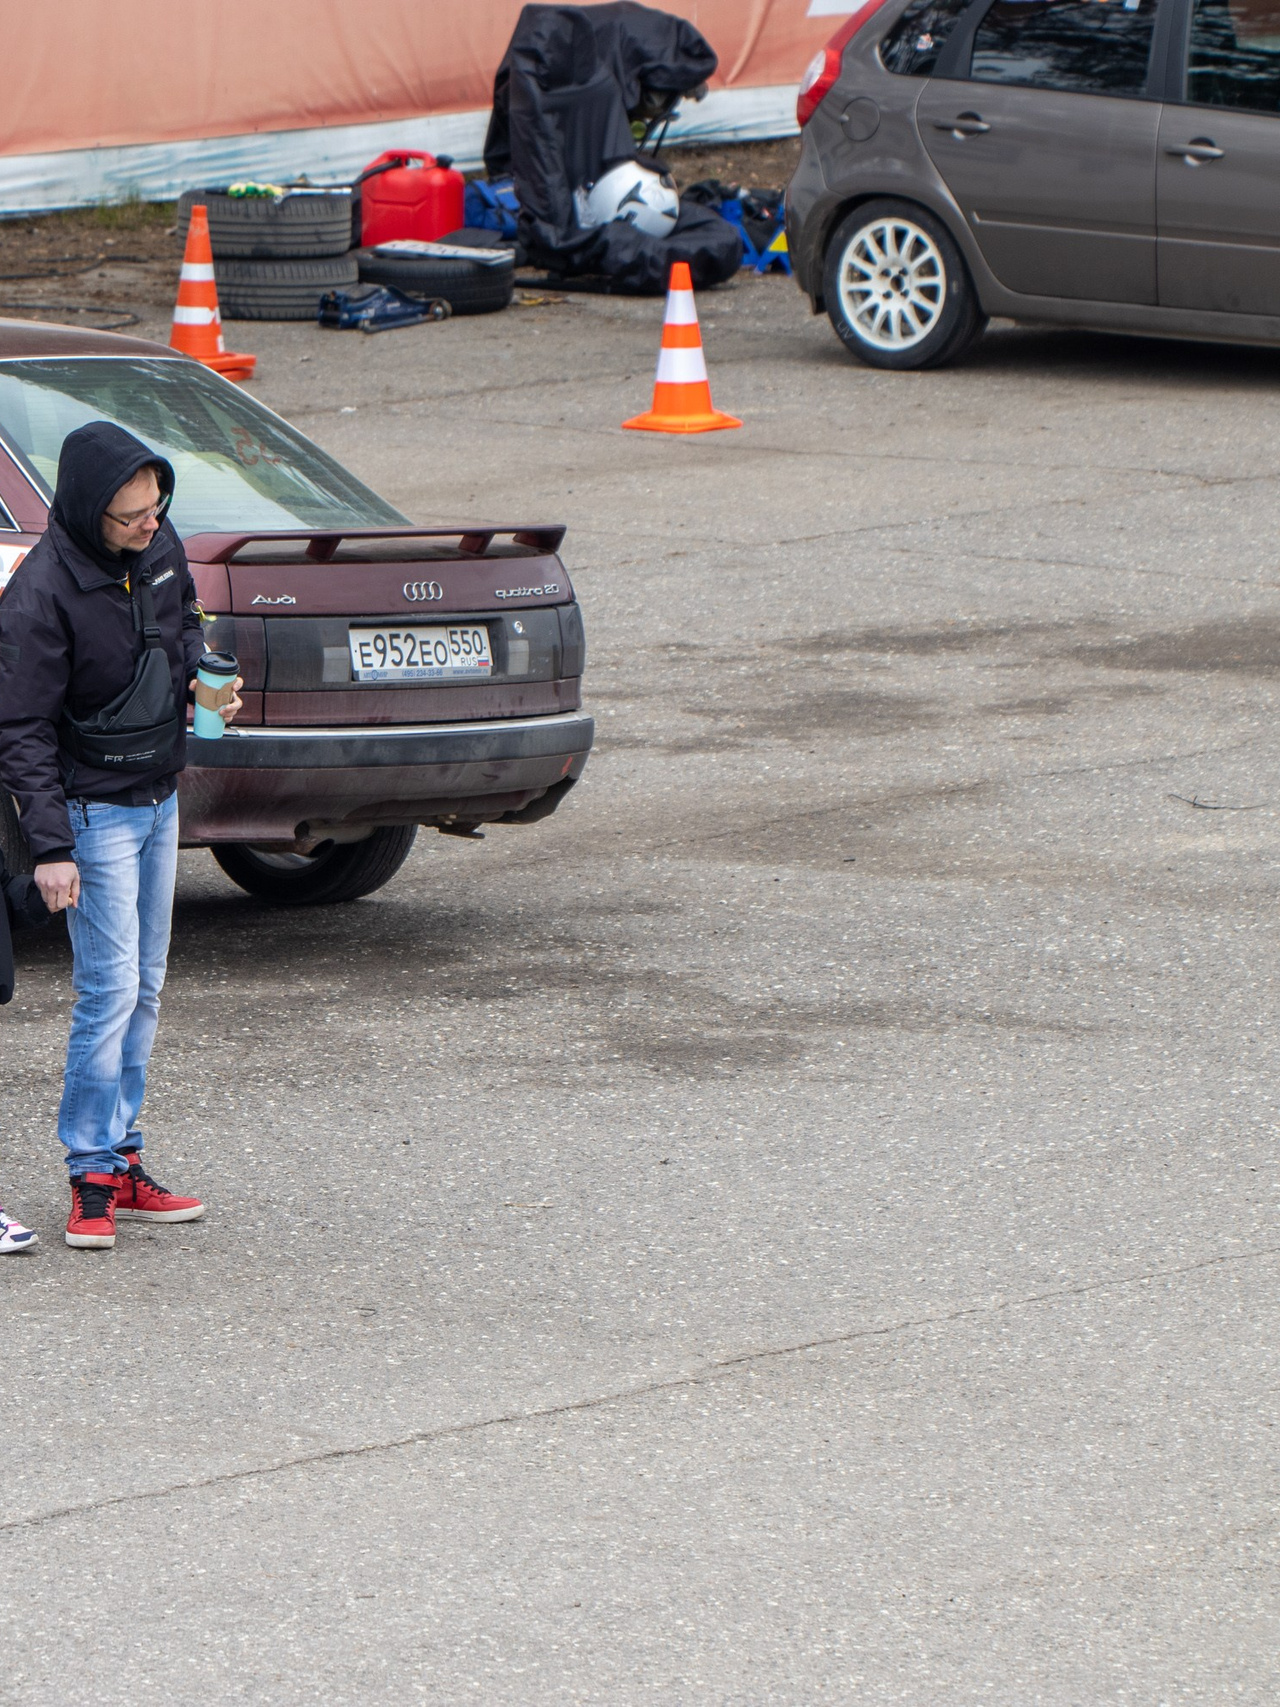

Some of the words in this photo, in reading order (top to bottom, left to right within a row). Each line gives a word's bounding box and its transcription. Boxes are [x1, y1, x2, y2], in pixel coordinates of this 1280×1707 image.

[251, 594, 297, 605] Audi
[449, 629, 484, 656] 550
[460, 657, 478, 666] RUS
